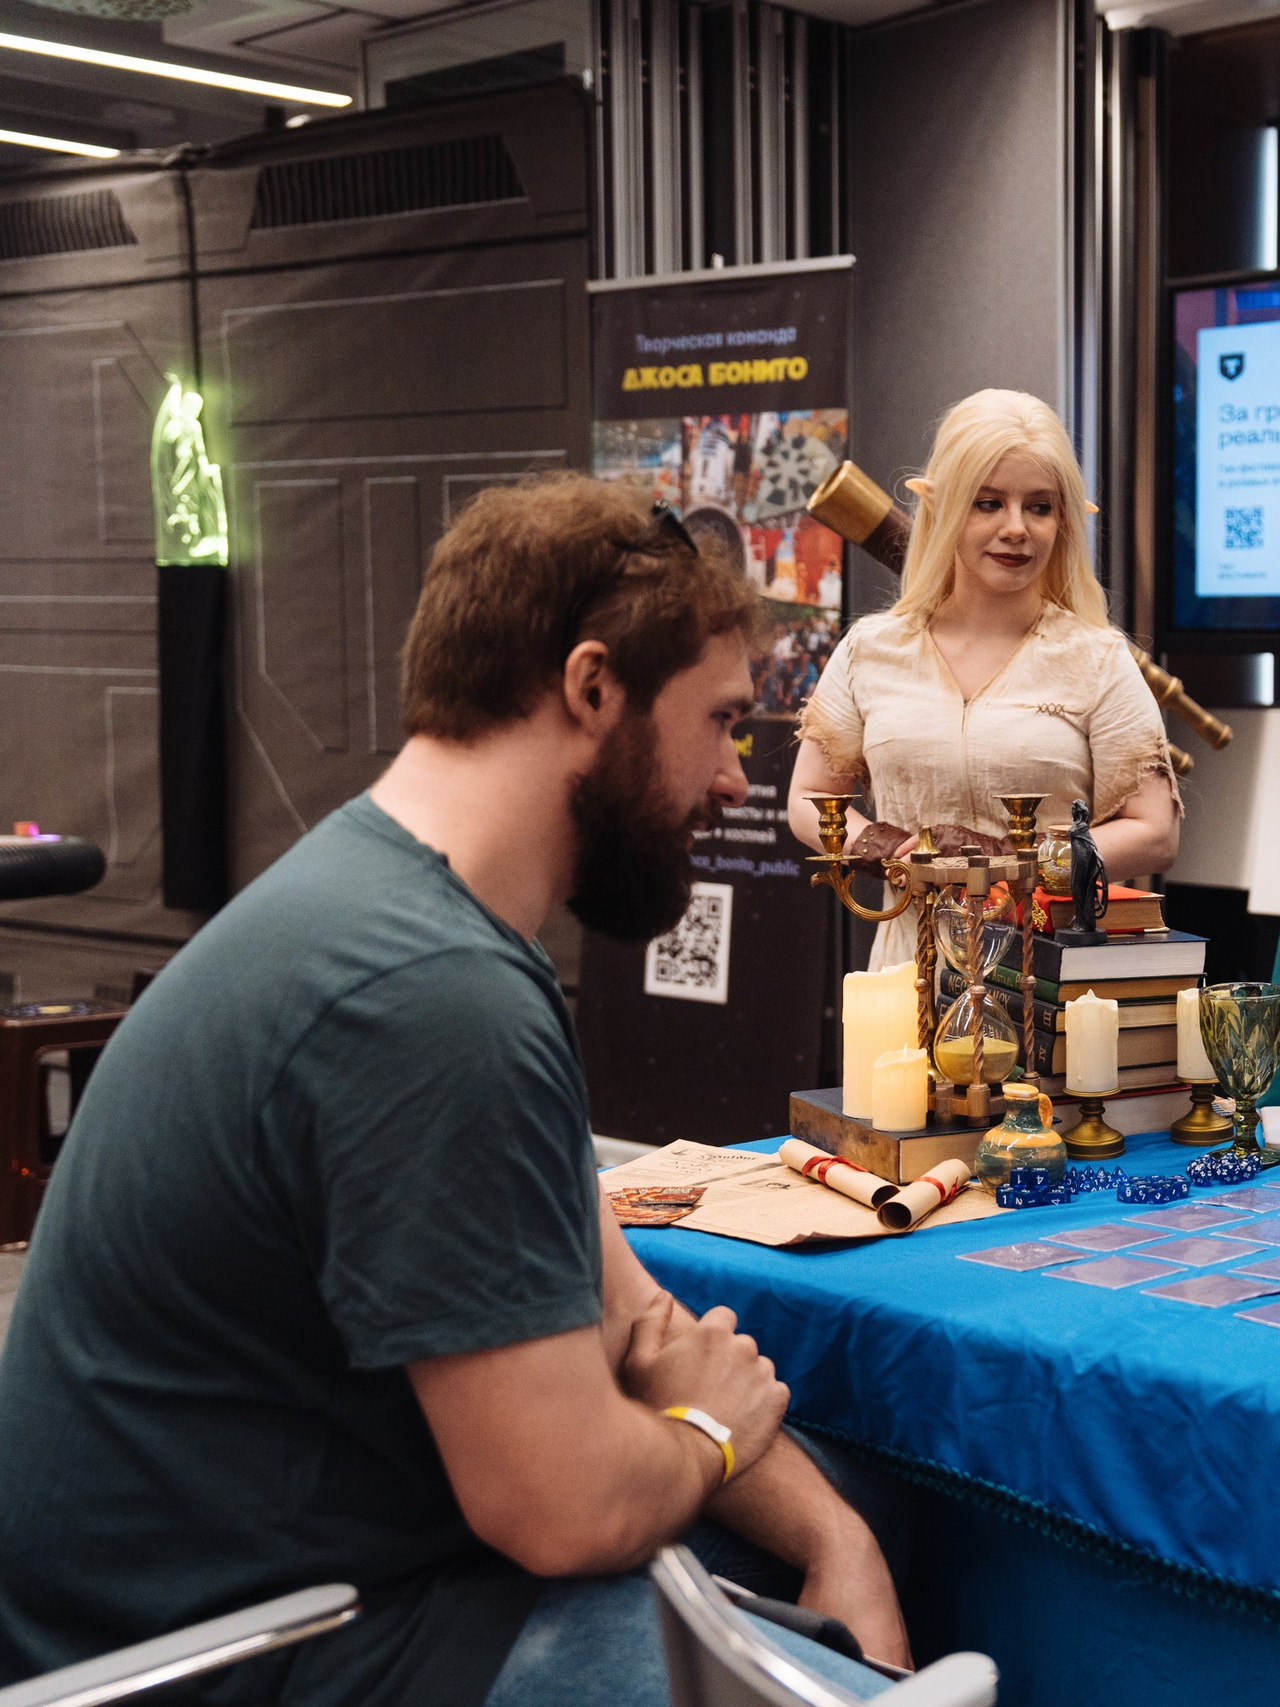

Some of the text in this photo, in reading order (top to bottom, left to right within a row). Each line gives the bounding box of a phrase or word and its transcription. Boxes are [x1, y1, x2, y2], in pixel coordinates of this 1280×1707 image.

[636, 327, 797, 354] Творческая команда
[622, 357, 809, 391] ДЖОСА БОНИТО
[1219, 403, 1248, 423] За
